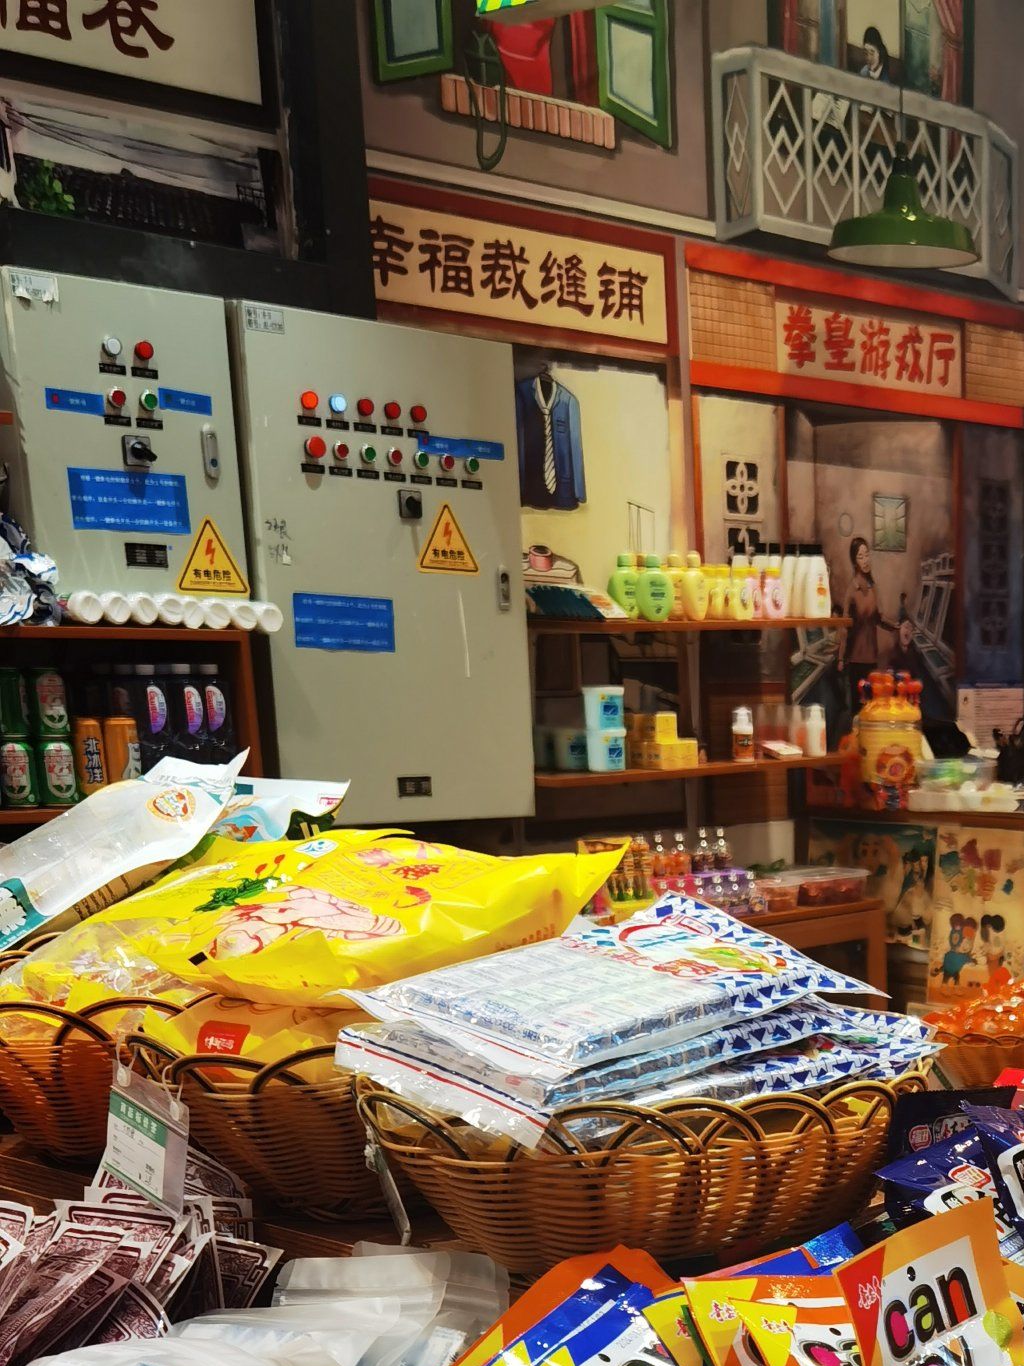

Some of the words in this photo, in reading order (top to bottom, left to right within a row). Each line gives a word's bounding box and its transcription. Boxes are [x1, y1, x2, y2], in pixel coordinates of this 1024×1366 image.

[369, 214, 648, 326] 幸福裁缝铺
[192, 568, 231, 581] 有电危险
[432, 548, 465, 561] 有电危险
[83, 737, 104, 784] 北冰洋
[882, 1264, 979, 1362] can
